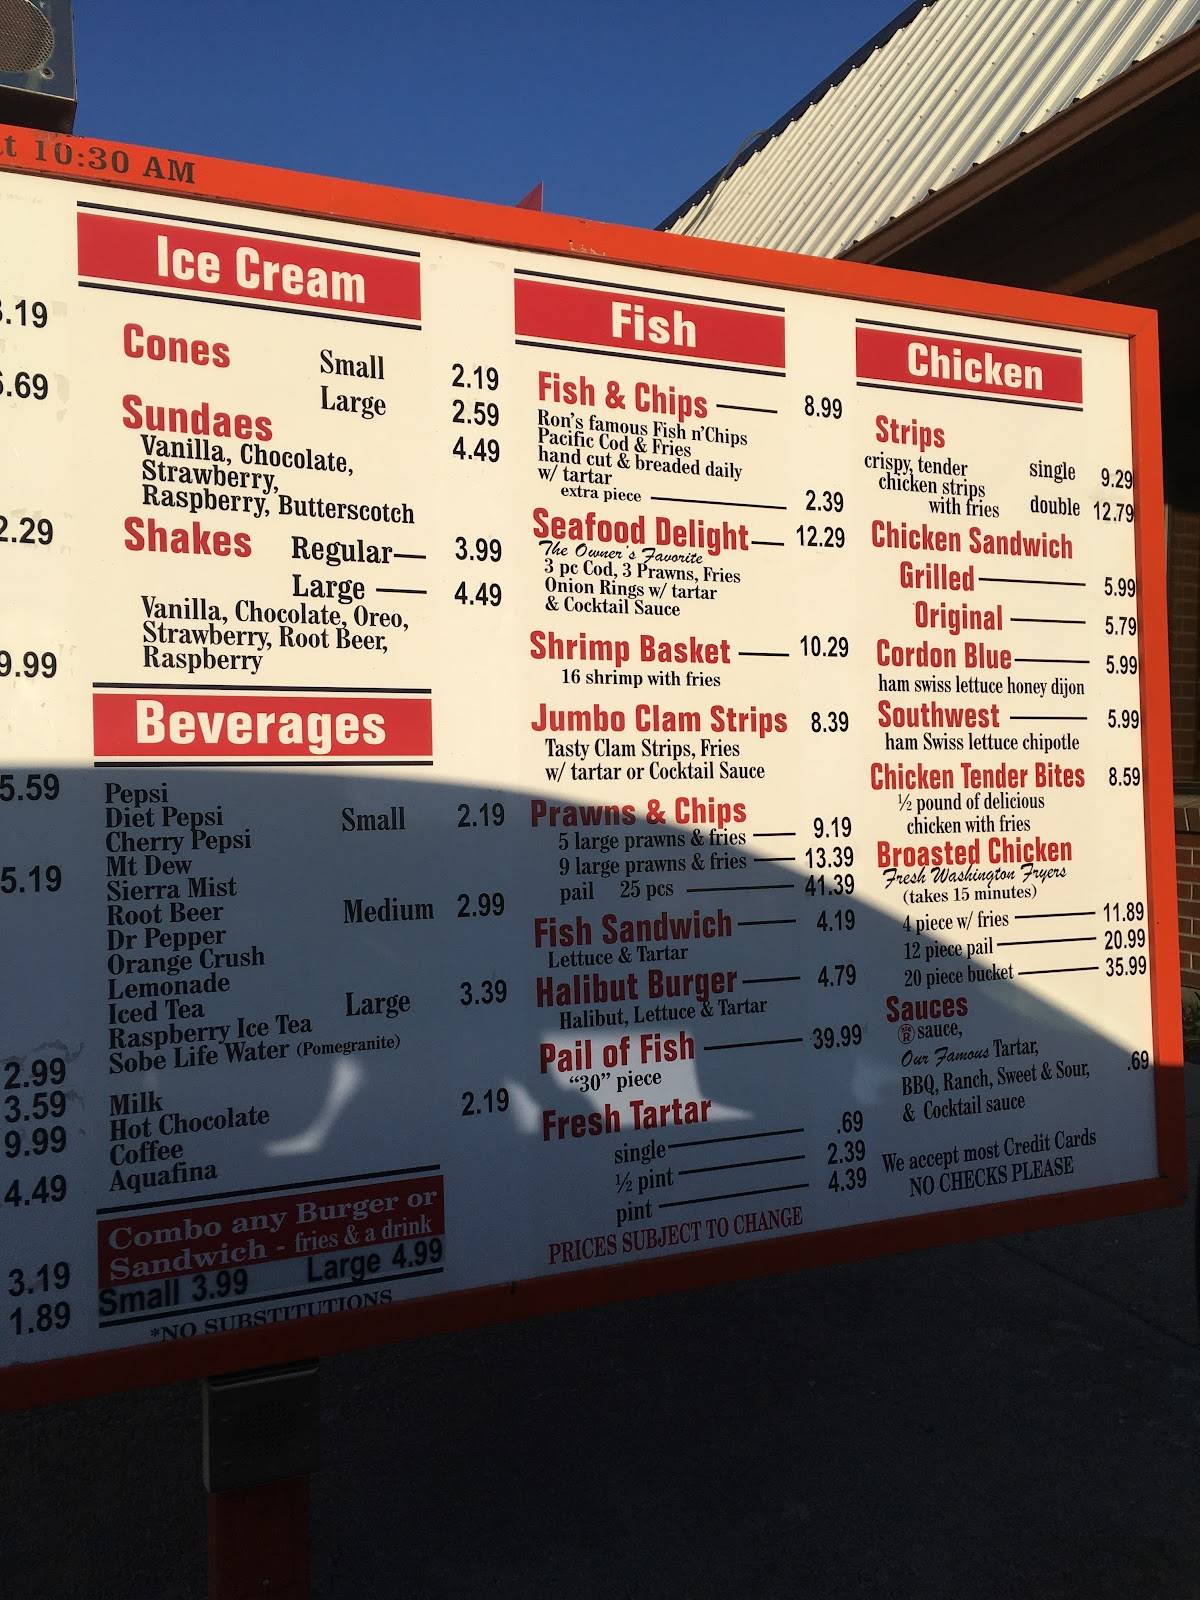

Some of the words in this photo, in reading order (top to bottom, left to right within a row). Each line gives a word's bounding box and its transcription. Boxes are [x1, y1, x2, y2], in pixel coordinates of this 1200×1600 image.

[35, 139, 129, 174] 10:30
[143, 156, 195, 184] AM
[157, 235, 220, 284] Ice
[236, 246, 365, 304] Cream
[611, 301, 696, 348] Fish
[123, 323, 230, 368] Cones
[320, 349, 384, 380] Small
[452, 363, 499, 390] 2.19
[907, 342, 1042, 391] Chicken
[320, 386, 386, 419] Large
[452, 400, 499, 426] 2.59
[538, 371, 595, 406] Fish
[606, 380, 625, 410] &
[635, 382, 707, 422] Chips
[805, 395, 842, 419] 8.99
[122, 394, 273, 441] Sundaes
[452, 436, 500, 462] 4.49
[589, 415, 648, 436] famous
[653, 421, 686, 440] Fish
[876, 415, 945, 452] Strips
[140, 434, 232, 465] Vanilla,
[240, 443, 353, 476] Chocolate,
[142, 459, 278, 494] Strawberry,
[538, 464, 558, 482] w/
[563, 467, 612, 485] tartar
[879, 472, 937, 494] chicken
[942, 479, 985, 498] strips
[1029, 460, 1075, 483] single
[1101, 468, 1133, 490] 9.29
[142, 484, 270, 518] Raspberry,
[278, 495, 415, 524] Butterscotch
[561, 486, 598, 500] extra
[604, 487, 642, 502] piece
[806, 490, 844, 512] 2.39
[1030, 495, 1080, 516] double
[1093, 502, 1134, 522] 12.79
[124, 516, 251, 558] Shakes
[291, 536, 392, 566] Regular
[455, 536, 501, 562] 3.99
[533, 508, 645, 544] Seafood
[656, 517, 749, 556] Delight
[796, 525, 845, 548] 12.29
[871, 520, 961, 552] Chicken
[969, 526, 1073, 559] Sandwich
[292, 574, 365, 604] Large
[455, 581, 501, 606] 4.49
[900, 561, 974, 591] Grilled
[1104, 577, 1136, 597] 5.99
[915, 600, 1003, 636] Original
[1105, 615, 1137, 636] 5.79
[530, 631, 630, 667] Shrimp
[640, 635, 730, 664] Basket
[800, 635, 849, 658] 10.29
[877, 639, 956, 668] Cordon
[965, 642, 1012, 669] Blue
[1106, 655, 1137, 675] 5.99
[562, 669, 580, 685] 16
[586, 670, 643, 688] shrimp
[647, 670, 680, 686] with
[686, 672, 721, 687] fries
[878, 674, 909, 692] ham
[914, 675, 951, 692] swiss
[956, 676, 1003, 694] lettuce
[1007, 678, 1047, 698] honey
[1051, 678, 1085, 698] dijon
[136, 699, 386, 755] Beverages
[531, 703, 625, 732] Jumbo
[635, 704, 700, 733] Clam
[710, 705, 787, 738] Strips
[811, 711, 849, 733] 8.39
[878, 700, 999, 728] Southwest
[1108, 709, 1139, 729] 5.99
[545, 738, 589, 760] Tasty
[594, 738, 636, 758] Clam
[642, 738, 696, 760] Strips,
[700, 739, 740, 757] Fries
[871, 763, 954, 790] Chicken
[961, 762, 1028, 788] Tender
[1035, 762, 1085, 787] Bites
[1109, 767, 1140, 786] 8.59
[105, 783, 168, 809] Pepsi
[105, 808, 155, 828] Diet
[162, 806, 223, 831] Pepsi
[342, 806, 405, 832] Small
[457, 803, 504, 827] 2.19
[531, 800, 636, 827] Prawns
[646, 799, 665, 824] &
[675, 797, 746, 829] Chips
[813, 817, 852, 838] 9.19
[105, 831, 184, 855] Cherry
[191, 829, 251, 853] Pepsi
[805, 846, 854, 869] 13.39
[877, 838, 980, 868] Broasted
[989, 836, 1072, 864] Chicken
[1, 865, 62, 893] 5.19
[106, 856, 137, 877] Mt
[144, 855, 192, 876] Dew
[107, 880, 180, 901] Sierra
[187, 876, 237, 897] Mist
[107, 905, 162, 926] Root
[170, 902, 224, 923] Beer
[343, 897, 434, 923] Medium
[458, 893, 504, 917] 2.99
[1104, 902, 1144, 922] 11.89
[534, 916, 591, 948] Fish
[602, 909, 732, 945] Sandwich
[817, 909, 855, 932] 4.19
[1104, 929, 1145, 950] 20.99
[1106, 956, 1146, 976] 35.99
[108, 973, 230, 1000] Lemonade
[345, 992, 410, 1018] Large
[460, 980, 507, 1006] 3.39
[536, 973, 638, 1007] Halibut
[649, 969, 737, 1002] Burger
[818, 964, 856, 987] 4.79
[108, 1001, 157, 1024] Iced
[165, 999, 205, 1020] Tea
[886, 996, 968, 1023] Sauces
[540, 1040, 591, 1073] Pail
[603, 1036, 629, 1067] of
[640, 1031, 695, 1063] Fish
[812, 1024, 862, 1050] 39.99
[4, 1057, 65, 1089] 2.99
[617, 1072, 662, 1092] piece
[4, 1091, 66, 1123] 3.59
[110, 1091, 163, 1116] Milk
[462, 1088, 509, 1116] 2.19
[110, 1117, 152, 1141] Hot
[159, 1105, 270, 1136] Chocolate
[542, 1103, 620, 1141] Fresh
[630, 1099, 711, 1131] Tartar
[4, 1126, 66, 1158] 9.99
[110, 1140, 183, 1166] Coffee
[882, 1153, 904, 1173] We
[909, 1146, 959, 1170] accept
[964, 1140, 999, 1162] most
[1004, 1134, 1050, 1156] Credit
[1054, 1128, 1096, 1149] Cards
[109, 1162, 217, 1193] Aquafina
[910, 1176, 934, 1197] NO
[940, 1166, 1008, 1192] CHECKS
[1012, 1156, 1074, 1182] PLEASE
[548, 1235, 617, 1265] PRICES
[622, 1221, 701, 1252] SUBJECT
[706, 1218, 729, 1239] TO
[733, 1206, 802, 1235] CHANGE
[8, 1261, 70, 1297] 3.19
[9, 1301, 70, 1335] 1.89
